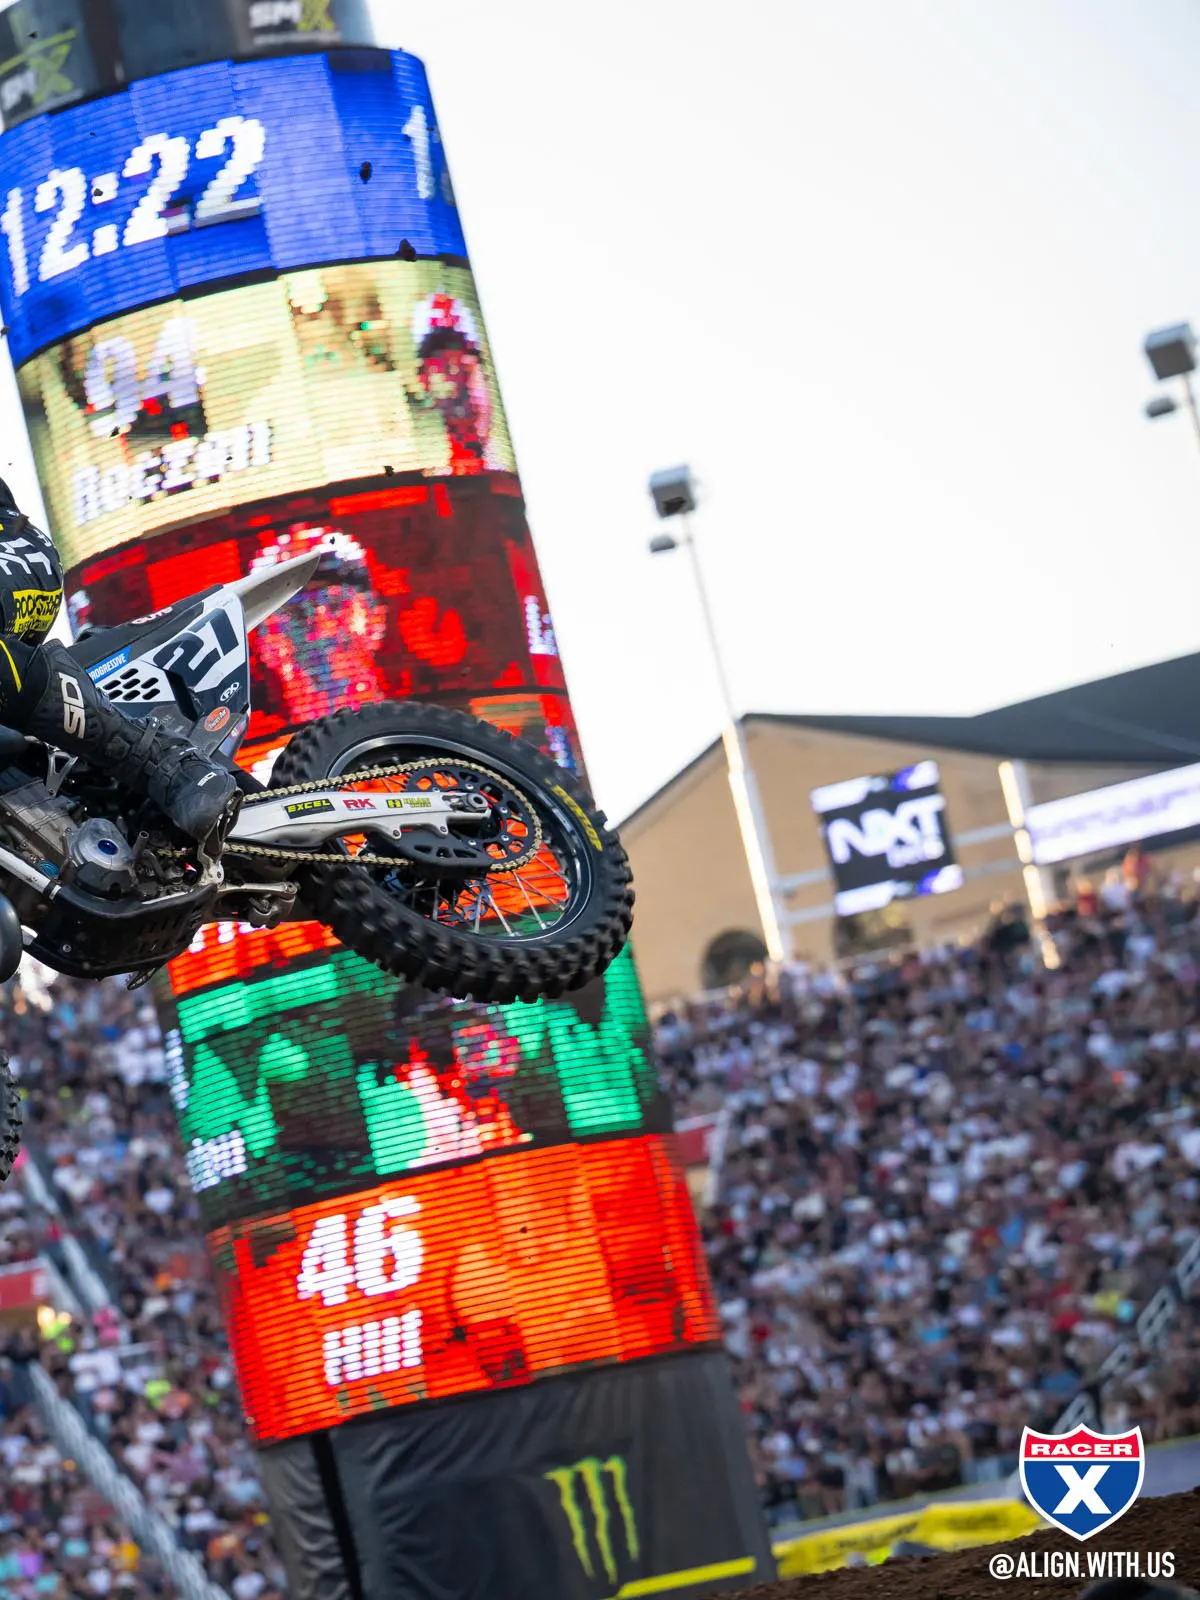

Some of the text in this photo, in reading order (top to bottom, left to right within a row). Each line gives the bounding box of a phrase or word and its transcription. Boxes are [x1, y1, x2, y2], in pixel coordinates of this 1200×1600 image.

[0, 115, 266, 297] 12:22
[14, 591, 61, 619] ROCSTAR
[286, 799, 331, 813] EXCEL
[342, 798, 375, 809] RK
[296, 1195, 424, 1306] 46
